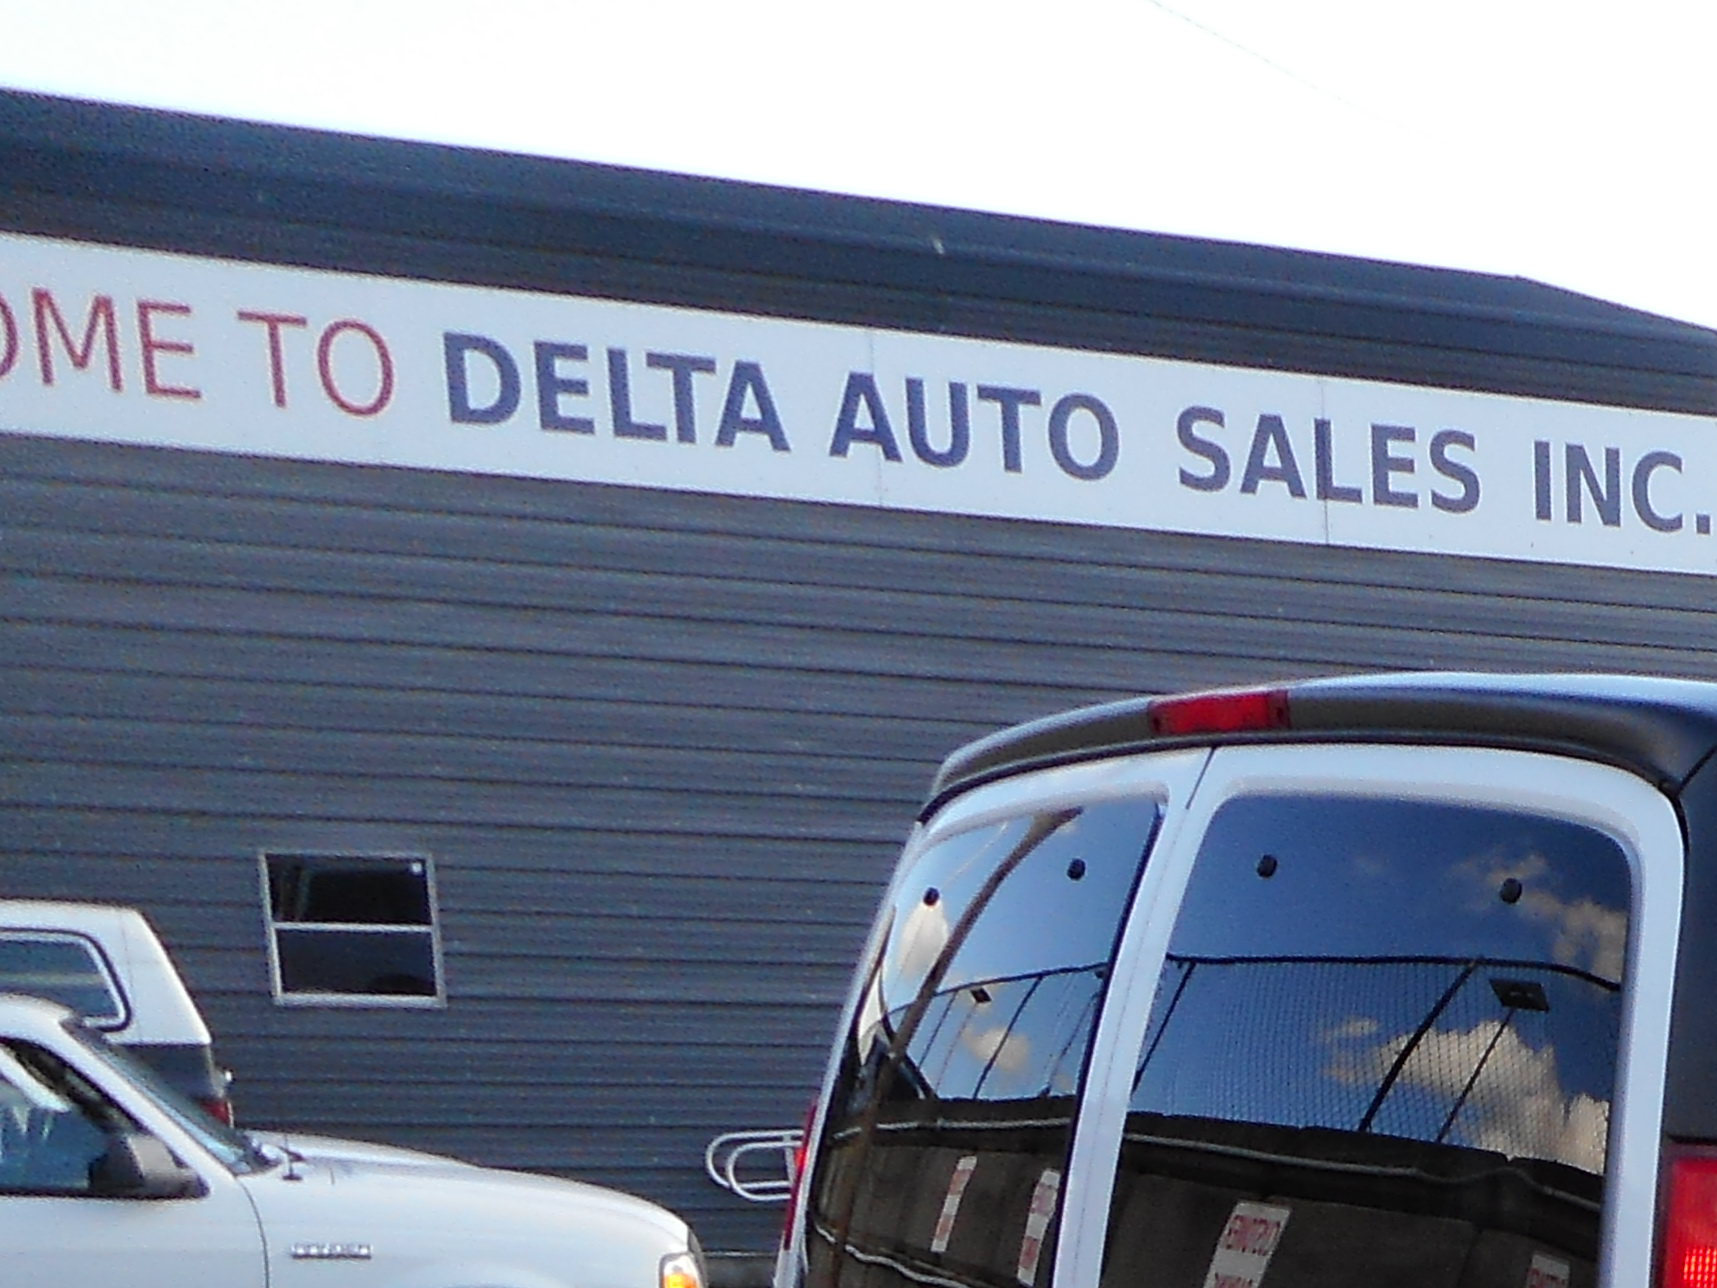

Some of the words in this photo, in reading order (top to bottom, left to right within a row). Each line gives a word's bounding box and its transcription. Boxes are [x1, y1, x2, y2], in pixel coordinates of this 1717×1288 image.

[0, 287, 203, 401] ME
[237, 310, 396, 418] TO
[442, 330, 792, 453] DELTA
[829, 370, 1120, 482] AUTO
[1177, 404, 1482, 515] SALES
[1533, 439, 1712, 536] INC.
